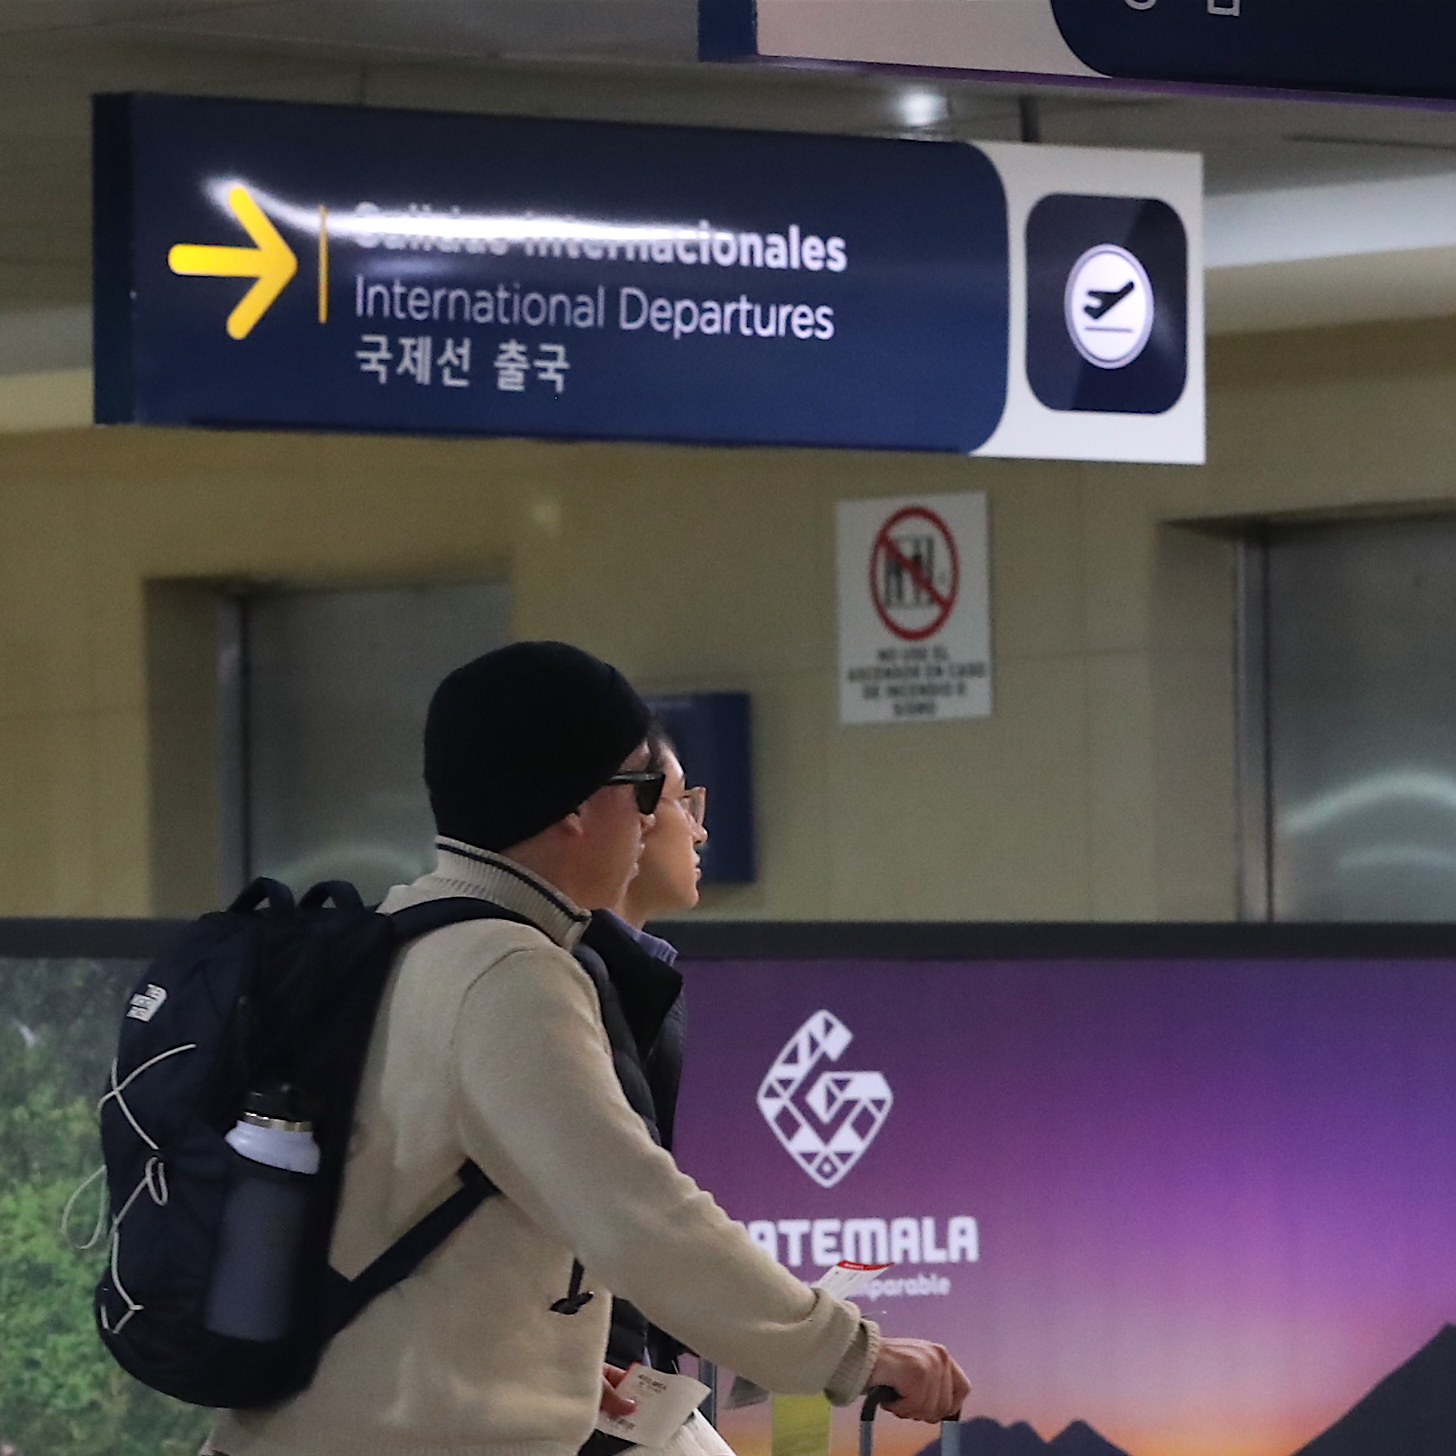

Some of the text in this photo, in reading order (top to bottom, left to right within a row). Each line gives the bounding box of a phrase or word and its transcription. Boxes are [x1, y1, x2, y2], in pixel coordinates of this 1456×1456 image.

[355, 275, 836, 341] International Departures
[355, 333, 571, 393] 국제선 출국
